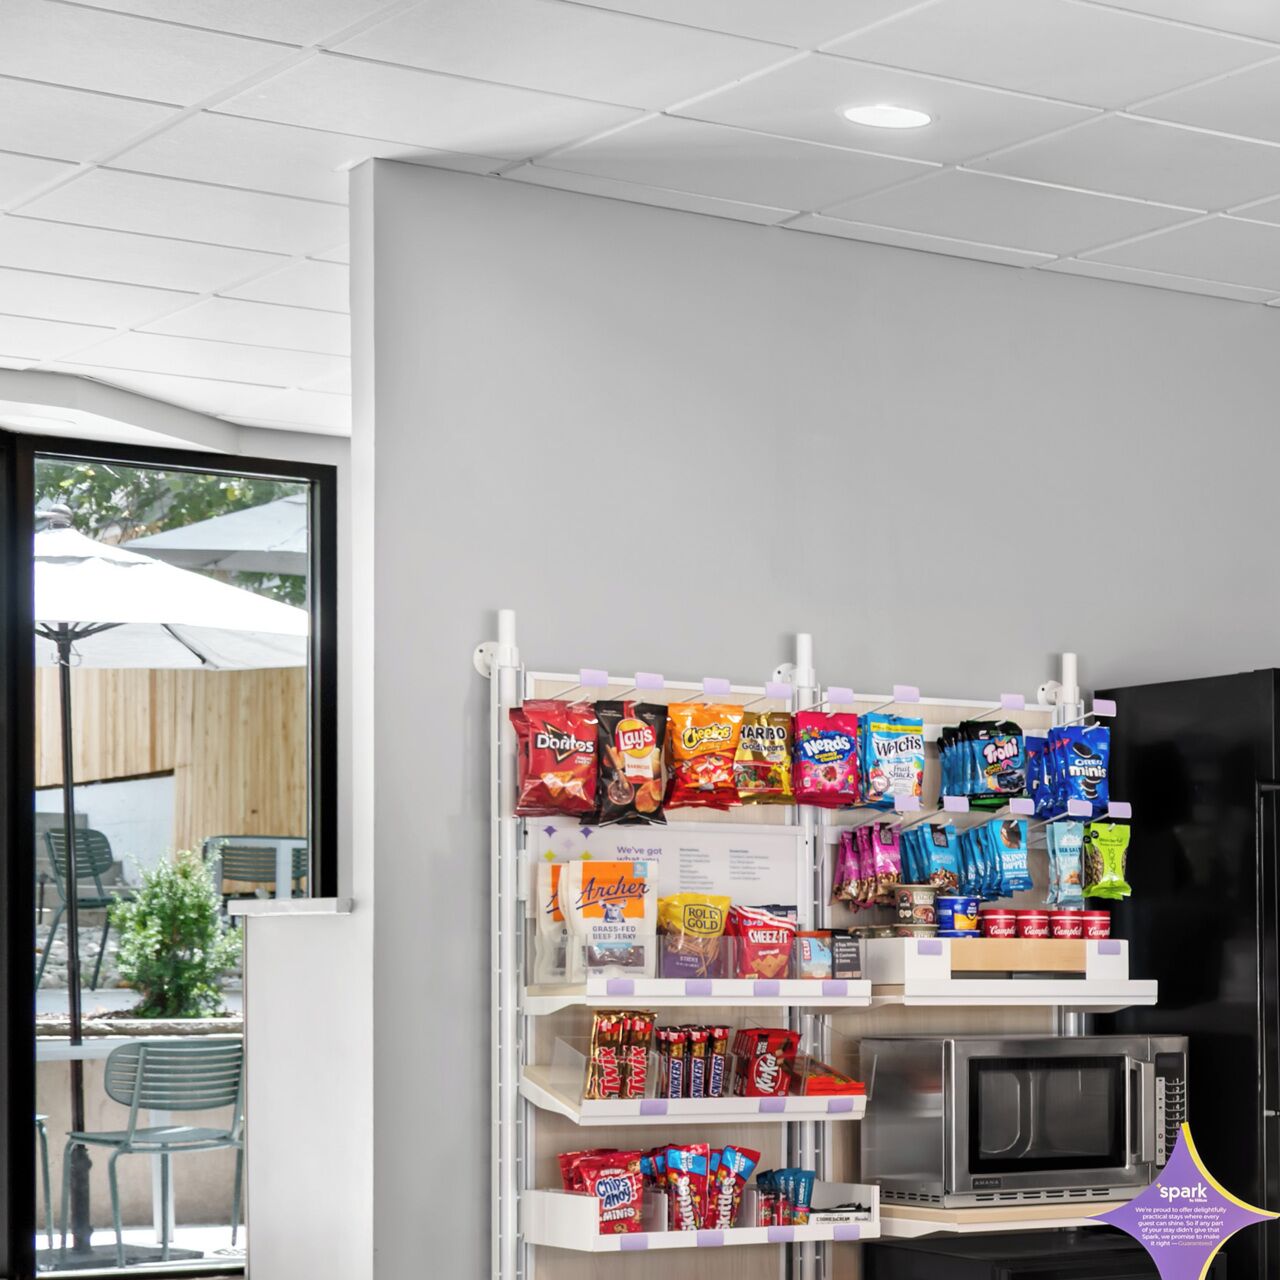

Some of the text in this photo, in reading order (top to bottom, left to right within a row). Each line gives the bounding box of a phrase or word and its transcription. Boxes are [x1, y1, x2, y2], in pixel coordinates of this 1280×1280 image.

[536, 732, 595, 753] Doritos
[618, 727, 654, 751] Lay's
[683, 724, 731, 749] Cheetos
[875, 735, 922, 757] Welch's
[983, 738, 1018, 764] Trolli
[616, 846, 663, 856] We've got
[576, 876, 650, 905] Archer
[687, 919, 719, 931] GOLD
[598, 1046, 620, 1098] Twix
[627, 1045, 647, 1098] Twix
[671, 1060, 681, 1098] SNICKERS
[693, 1060, 704, 1098] SNICKERS
[711, 1055, 724, 1096] SNICKERS
[596, 1176, 629, 1198] Chips
[1160, 1182, 1208, 1203] spark
[716, 1177, 736, 1230] Skittles
